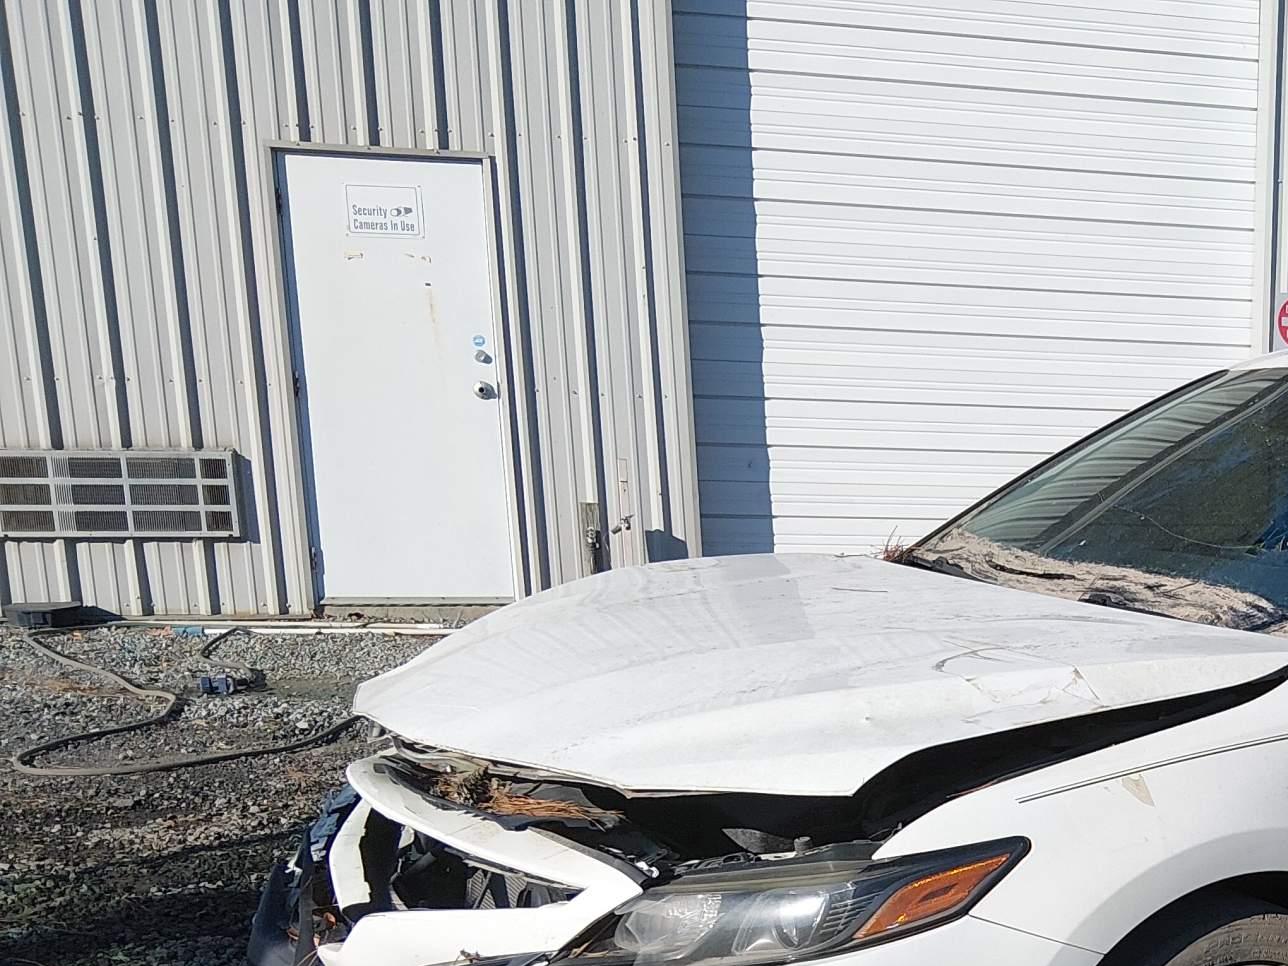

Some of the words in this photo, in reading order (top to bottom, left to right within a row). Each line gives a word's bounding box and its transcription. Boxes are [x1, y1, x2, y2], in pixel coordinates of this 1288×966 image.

[352, 204, 388, 219] Security
[353, 219, 388, 230] Cameras
[390, 220, 399, 231] In
[400, 220, 415, 232] Use
